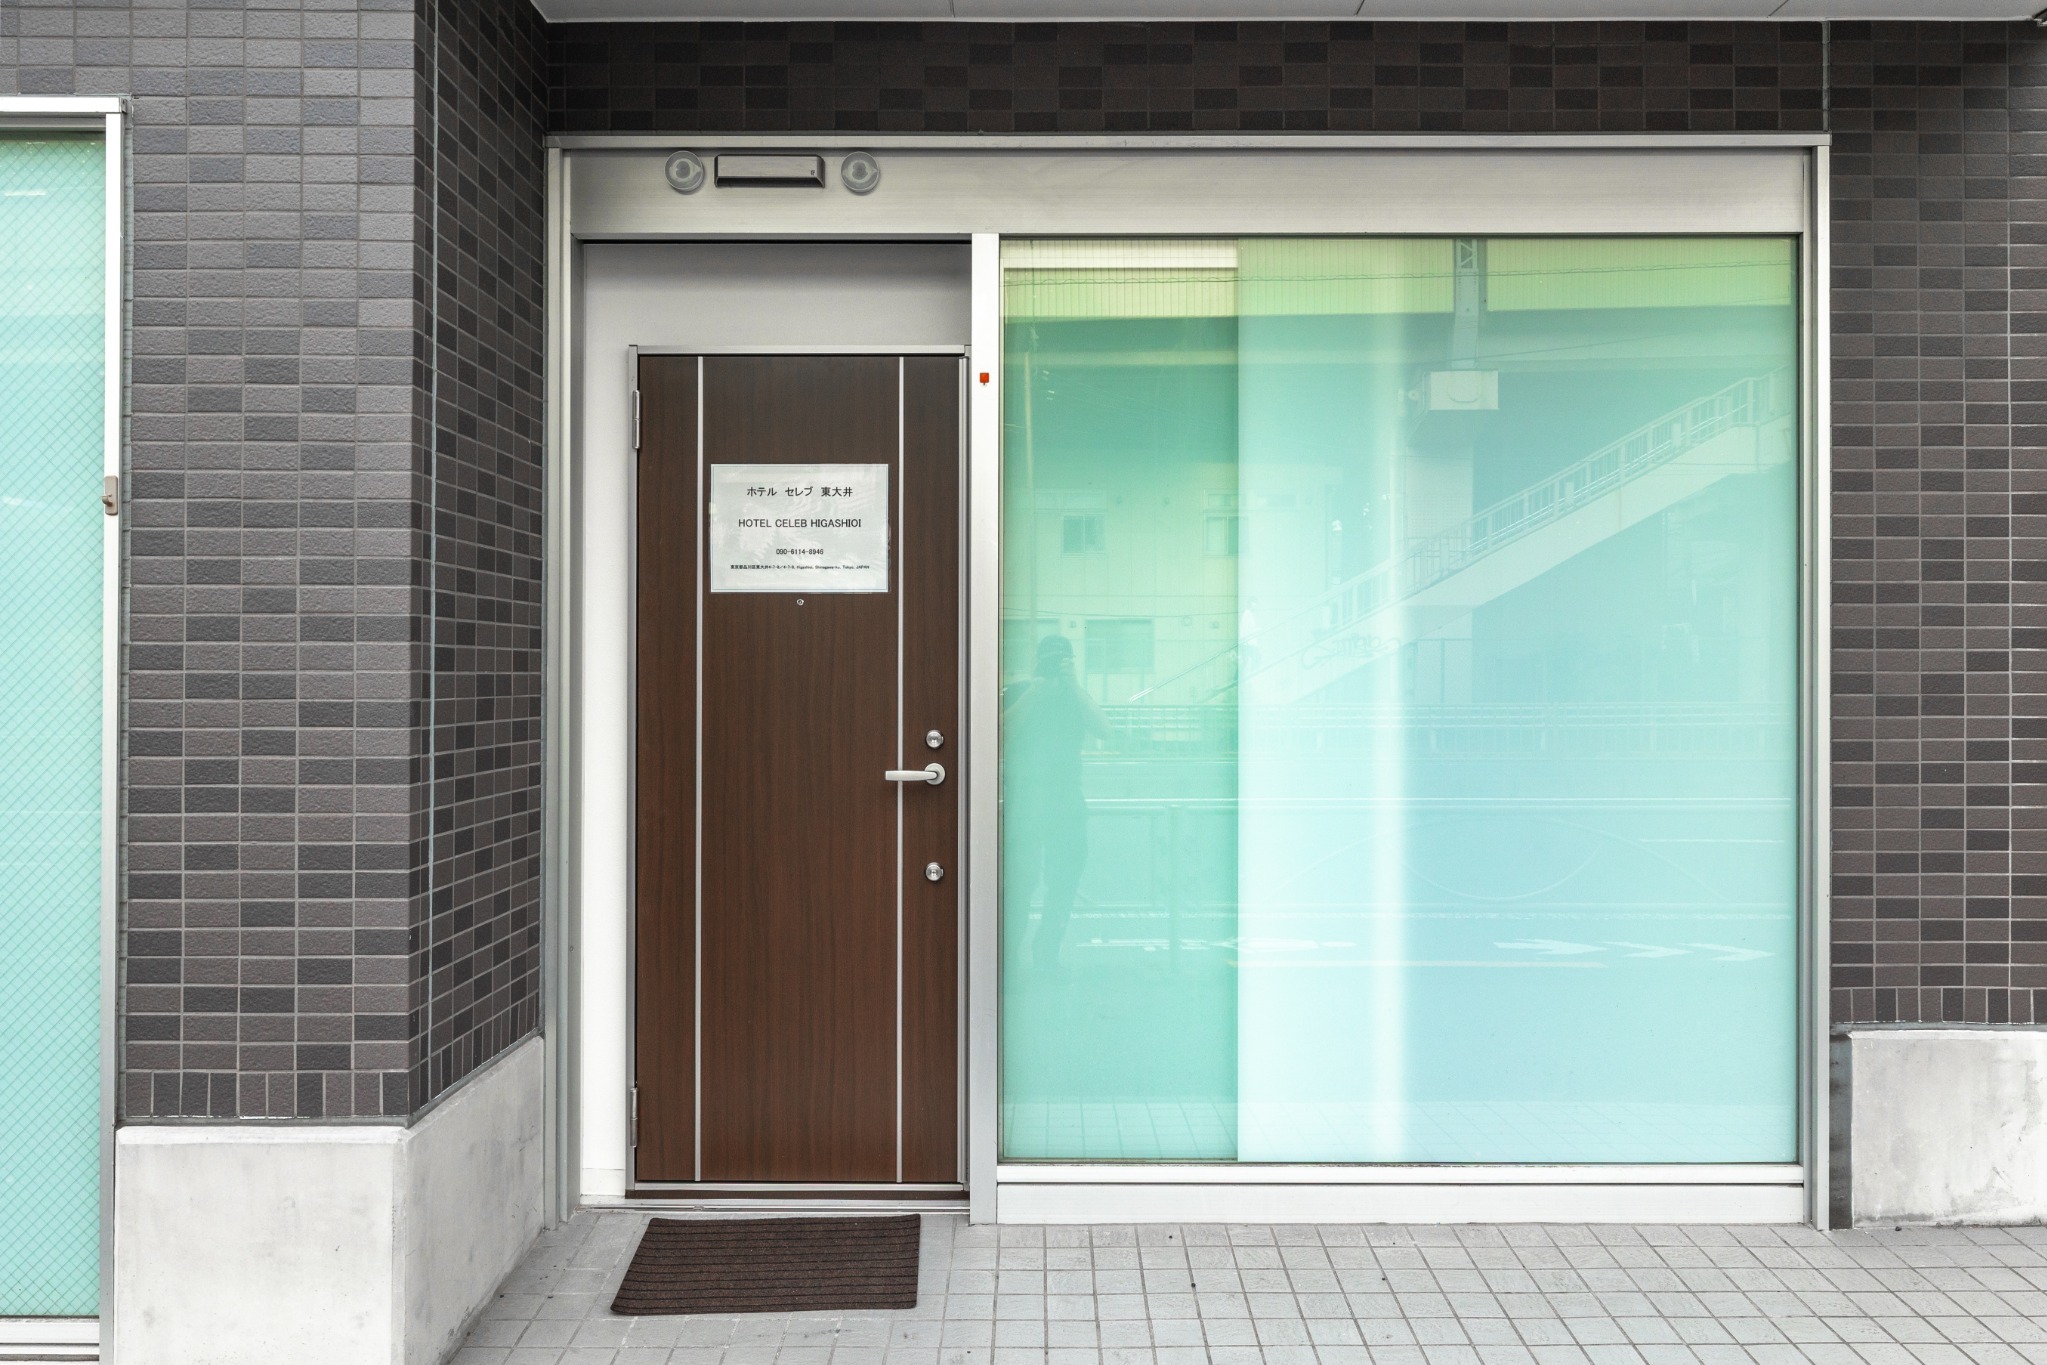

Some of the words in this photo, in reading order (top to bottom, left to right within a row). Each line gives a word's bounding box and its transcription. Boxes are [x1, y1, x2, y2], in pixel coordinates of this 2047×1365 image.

[747, 486, 777, 497] ホテル
[785, 486, 813, 497] セレブ
[820, 486, 853, 497] 東大井
[738, 518, 772, 528] HOTEL
[774, 518, 808, 528] CELEB
[810, 518, 861, 528] HIGASHIOI
